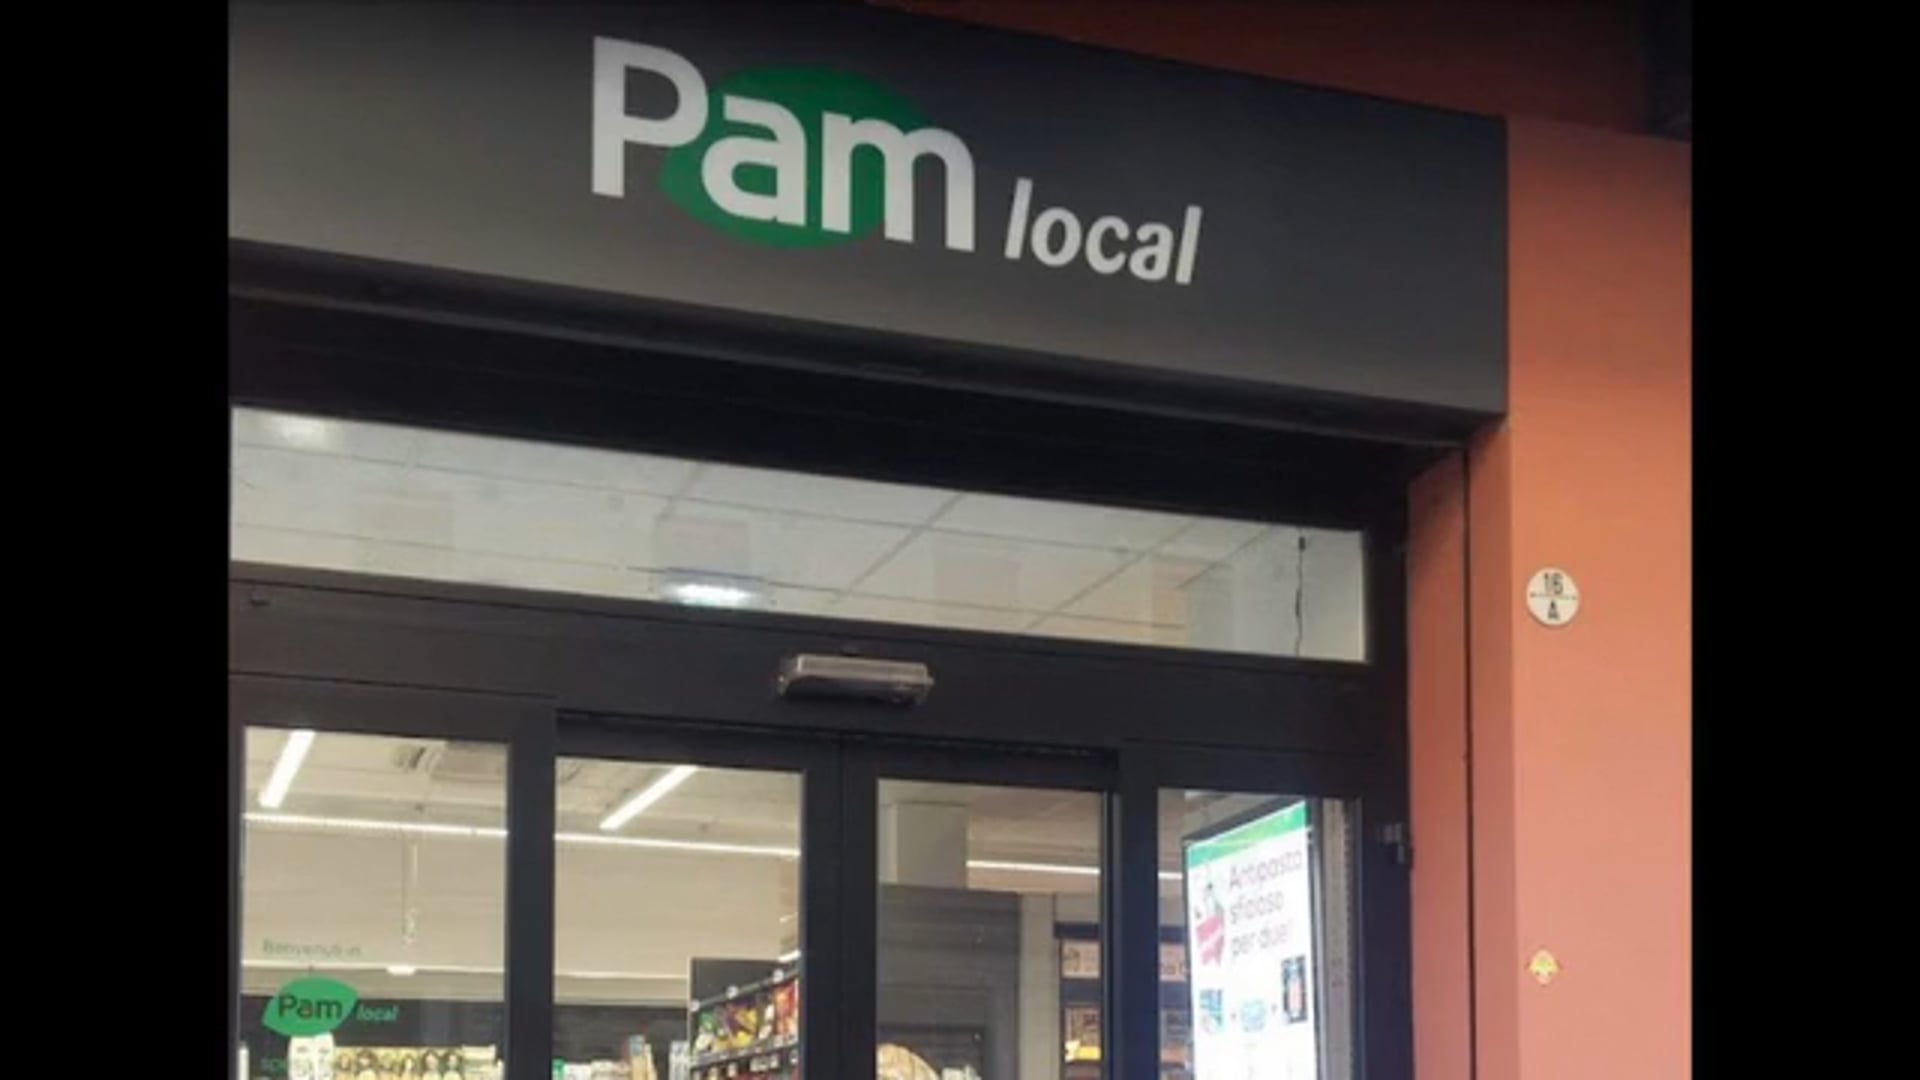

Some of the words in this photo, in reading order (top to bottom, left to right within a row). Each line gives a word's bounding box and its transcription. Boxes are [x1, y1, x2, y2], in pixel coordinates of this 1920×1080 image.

[592, 36, 975, 252] Pam
[1004, 178, 1202, 285] local
[1544, 571, 1564, 595] 16
[278, 993, 343, 1020] Pam
[356, 1004, 400, 1022] local
